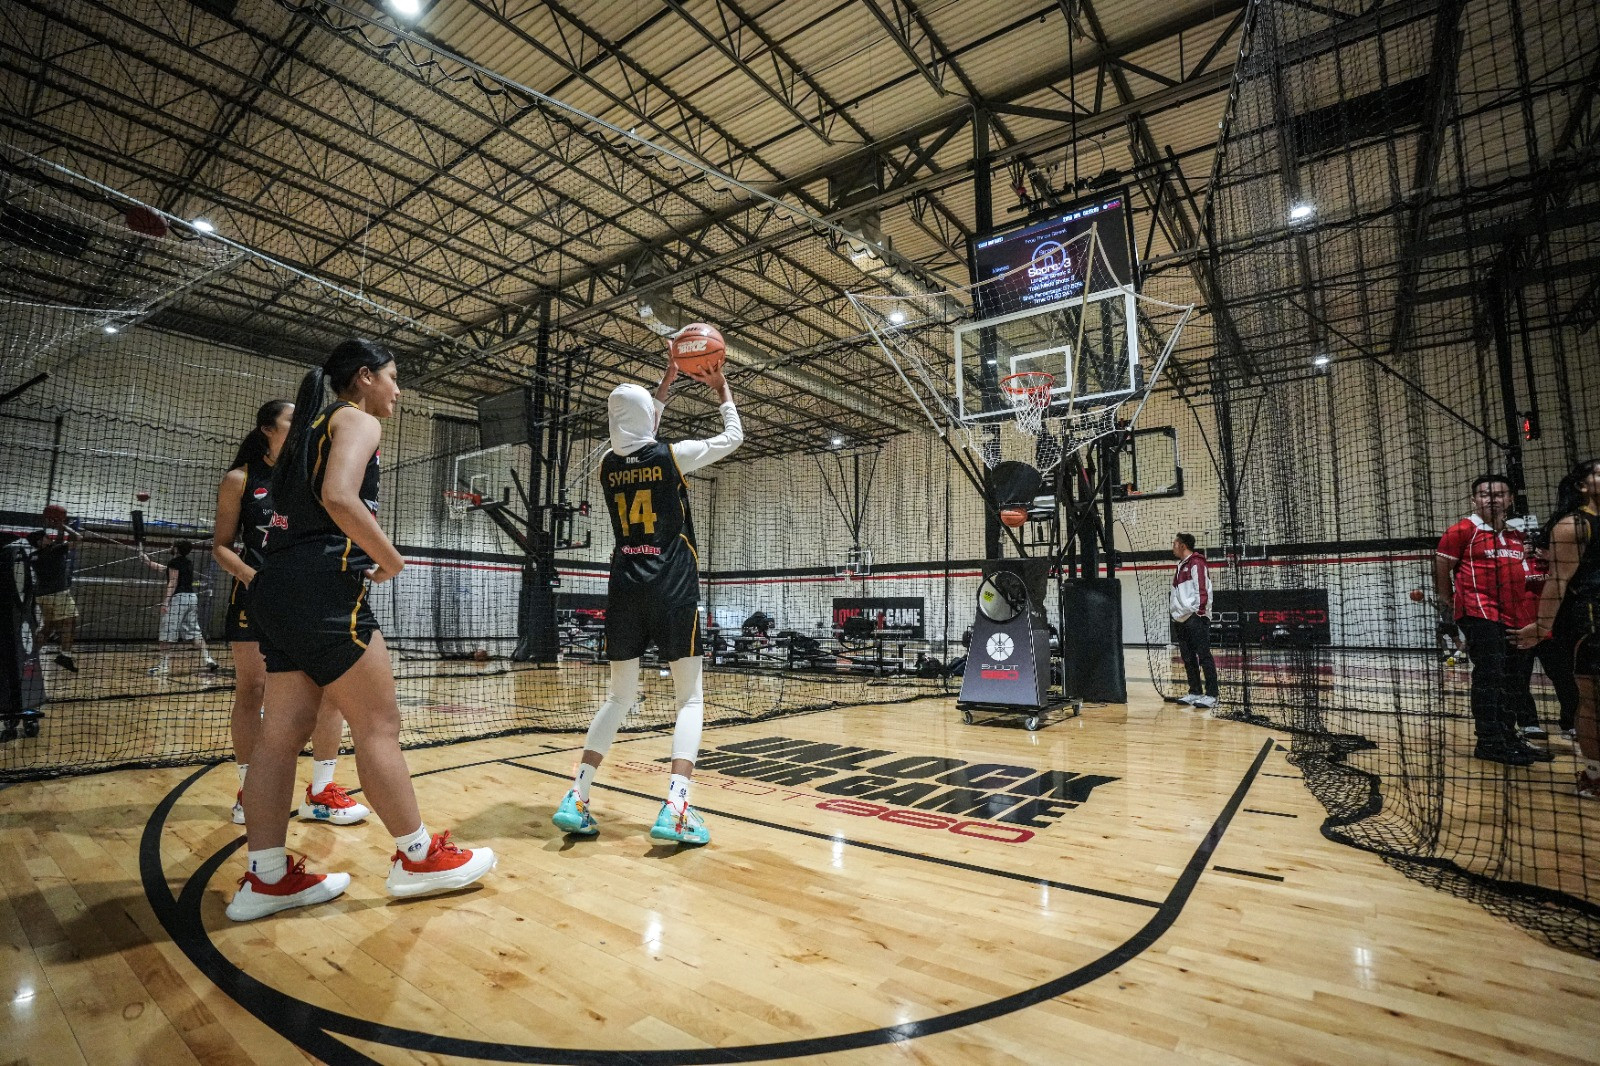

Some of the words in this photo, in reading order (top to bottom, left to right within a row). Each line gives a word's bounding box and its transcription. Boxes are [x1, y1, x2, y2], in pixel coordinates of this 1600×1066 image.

[1028, 263, 1061, 277] Score:
[1064, 258, 1071, 268] 3
[608, 466, 662, 487] SYAFIRA
[614, 489, 657, 536] 14
[886, 608, 920, 626] GAME
[714, 736, 1122, 802] UNLOCK
[815, 774, 1079, 829] GAME
